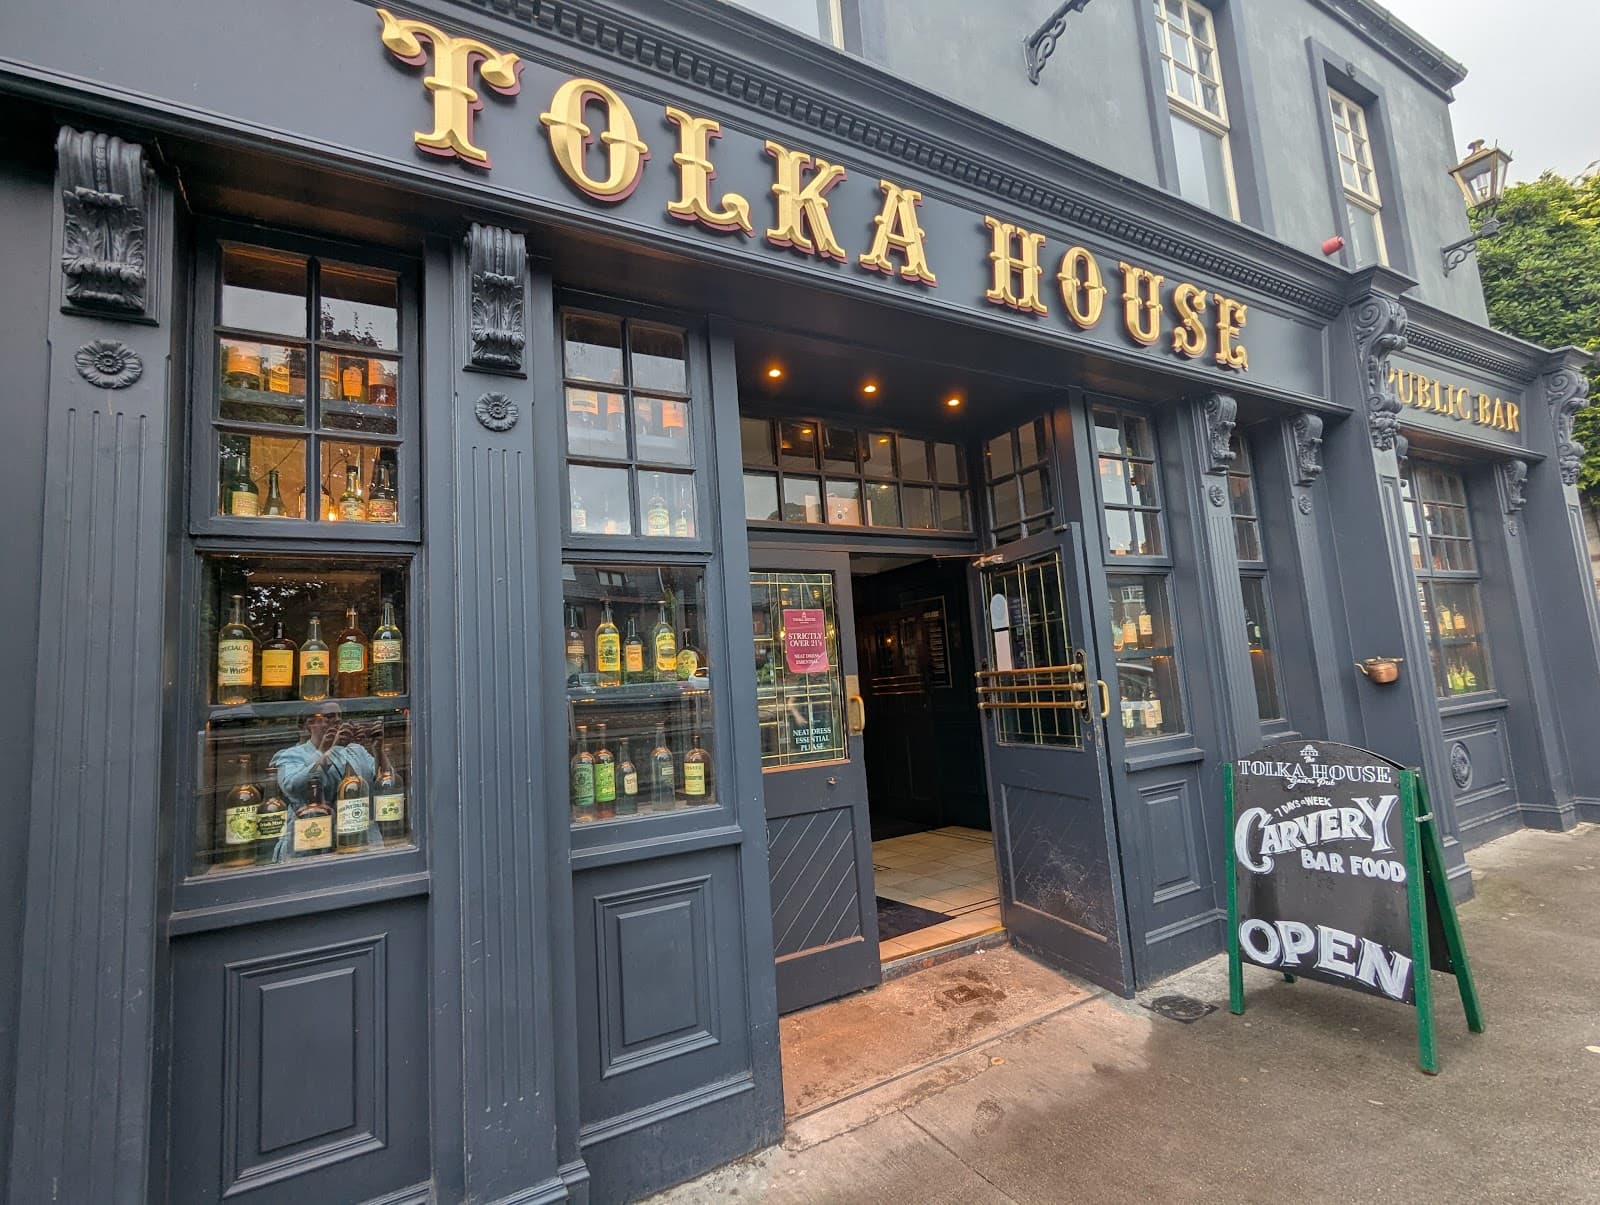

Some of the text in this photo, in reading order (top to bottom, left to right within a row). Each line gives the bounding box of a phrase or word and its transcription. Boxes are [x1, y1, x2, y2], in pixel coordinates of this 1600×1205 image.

[377, 8, 1249, 372] TOLKA HOUSE
[1477, 392, 1520, 433] BAR
[788, 632, 823, 640] STRICTLY
[792, 727, 832, 737] NEAT DRESS
[1238, 760, 1392, 783] TOLKA HOUSE
[1287, 776, 1336, 789] Gastro Pub
[1274, 808, 1283, 817] 7
[1281, 799, 1301, 815] DAYS
[1304, 795, 1332, 807] WEEK
[1235, 795, 1400, 874] CARVERY
[1301, 849, 1407, 883] BAR FOOD
[1239, 918, 1413, 1001] OPEN
